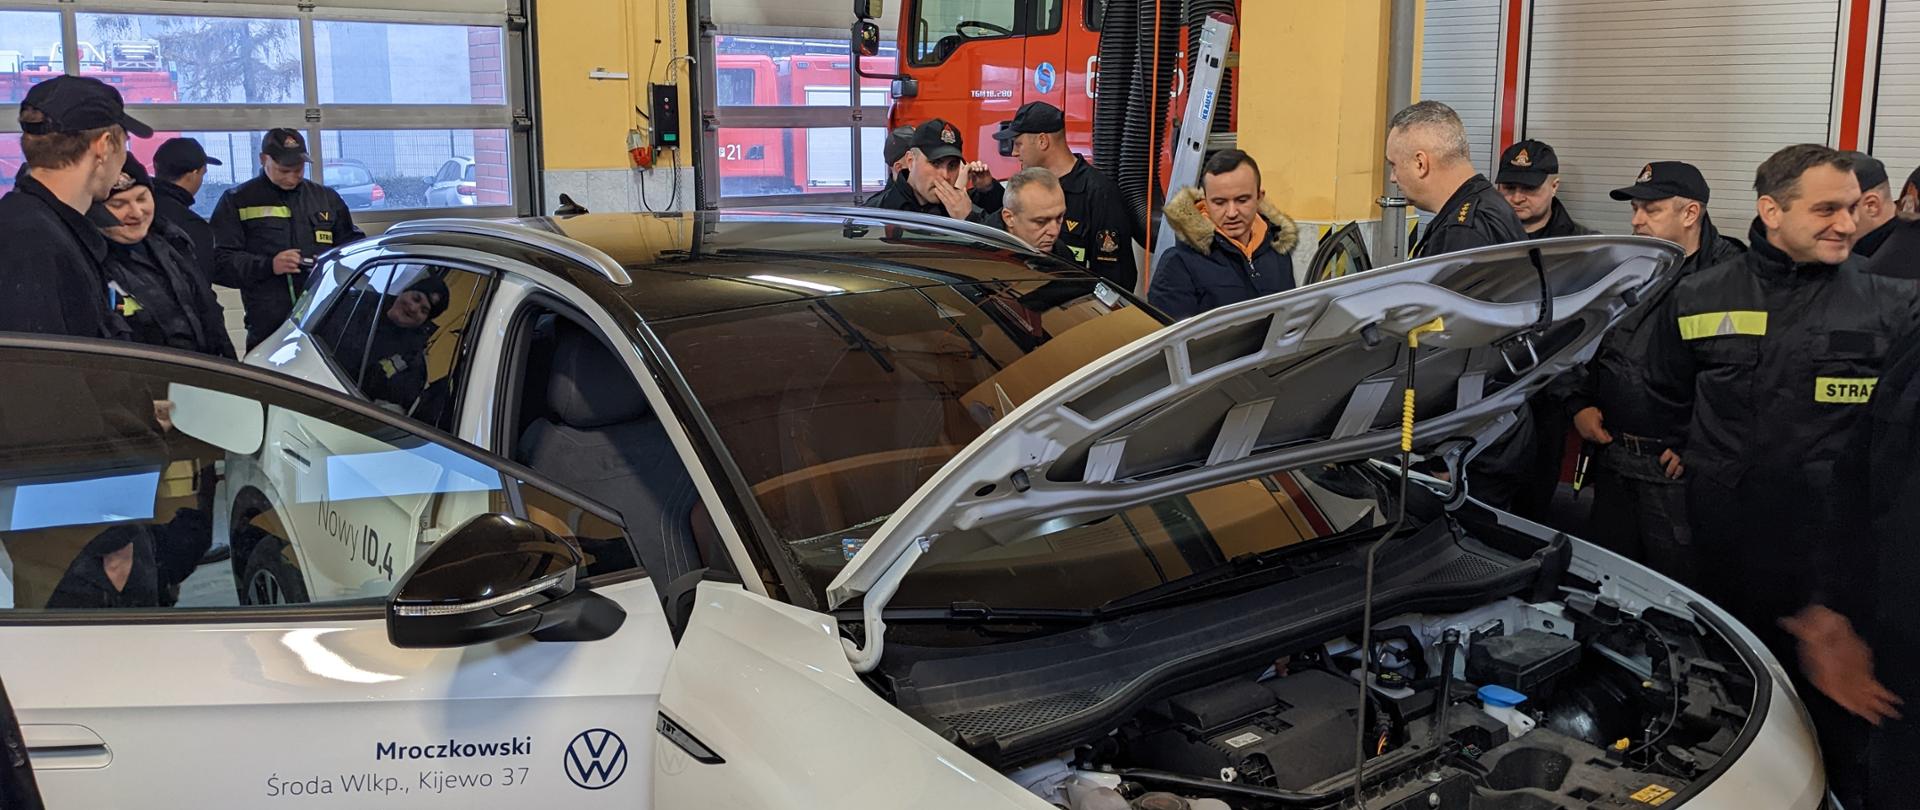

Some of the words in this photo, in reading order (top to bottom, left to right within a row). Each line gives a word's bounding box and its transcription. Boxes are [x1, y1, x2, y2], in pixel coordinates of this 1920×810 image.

[1202, 89, 1214, 121] KRAUSE
[727, 145, 741, 160] 21
[1825, 383, 1876, 398] STRA
[318, 494, 359, 562] Nowy
[362, 524, 394, 582] ID.4
[375, 735, 533, 761] Mroczkowski
[266, 772, 334, 797] Środa
[340, 772, 409, 796] Wlkp.,
[418, 769, 494, 794] Kijewo
[501, 767, 530, 787] 37
